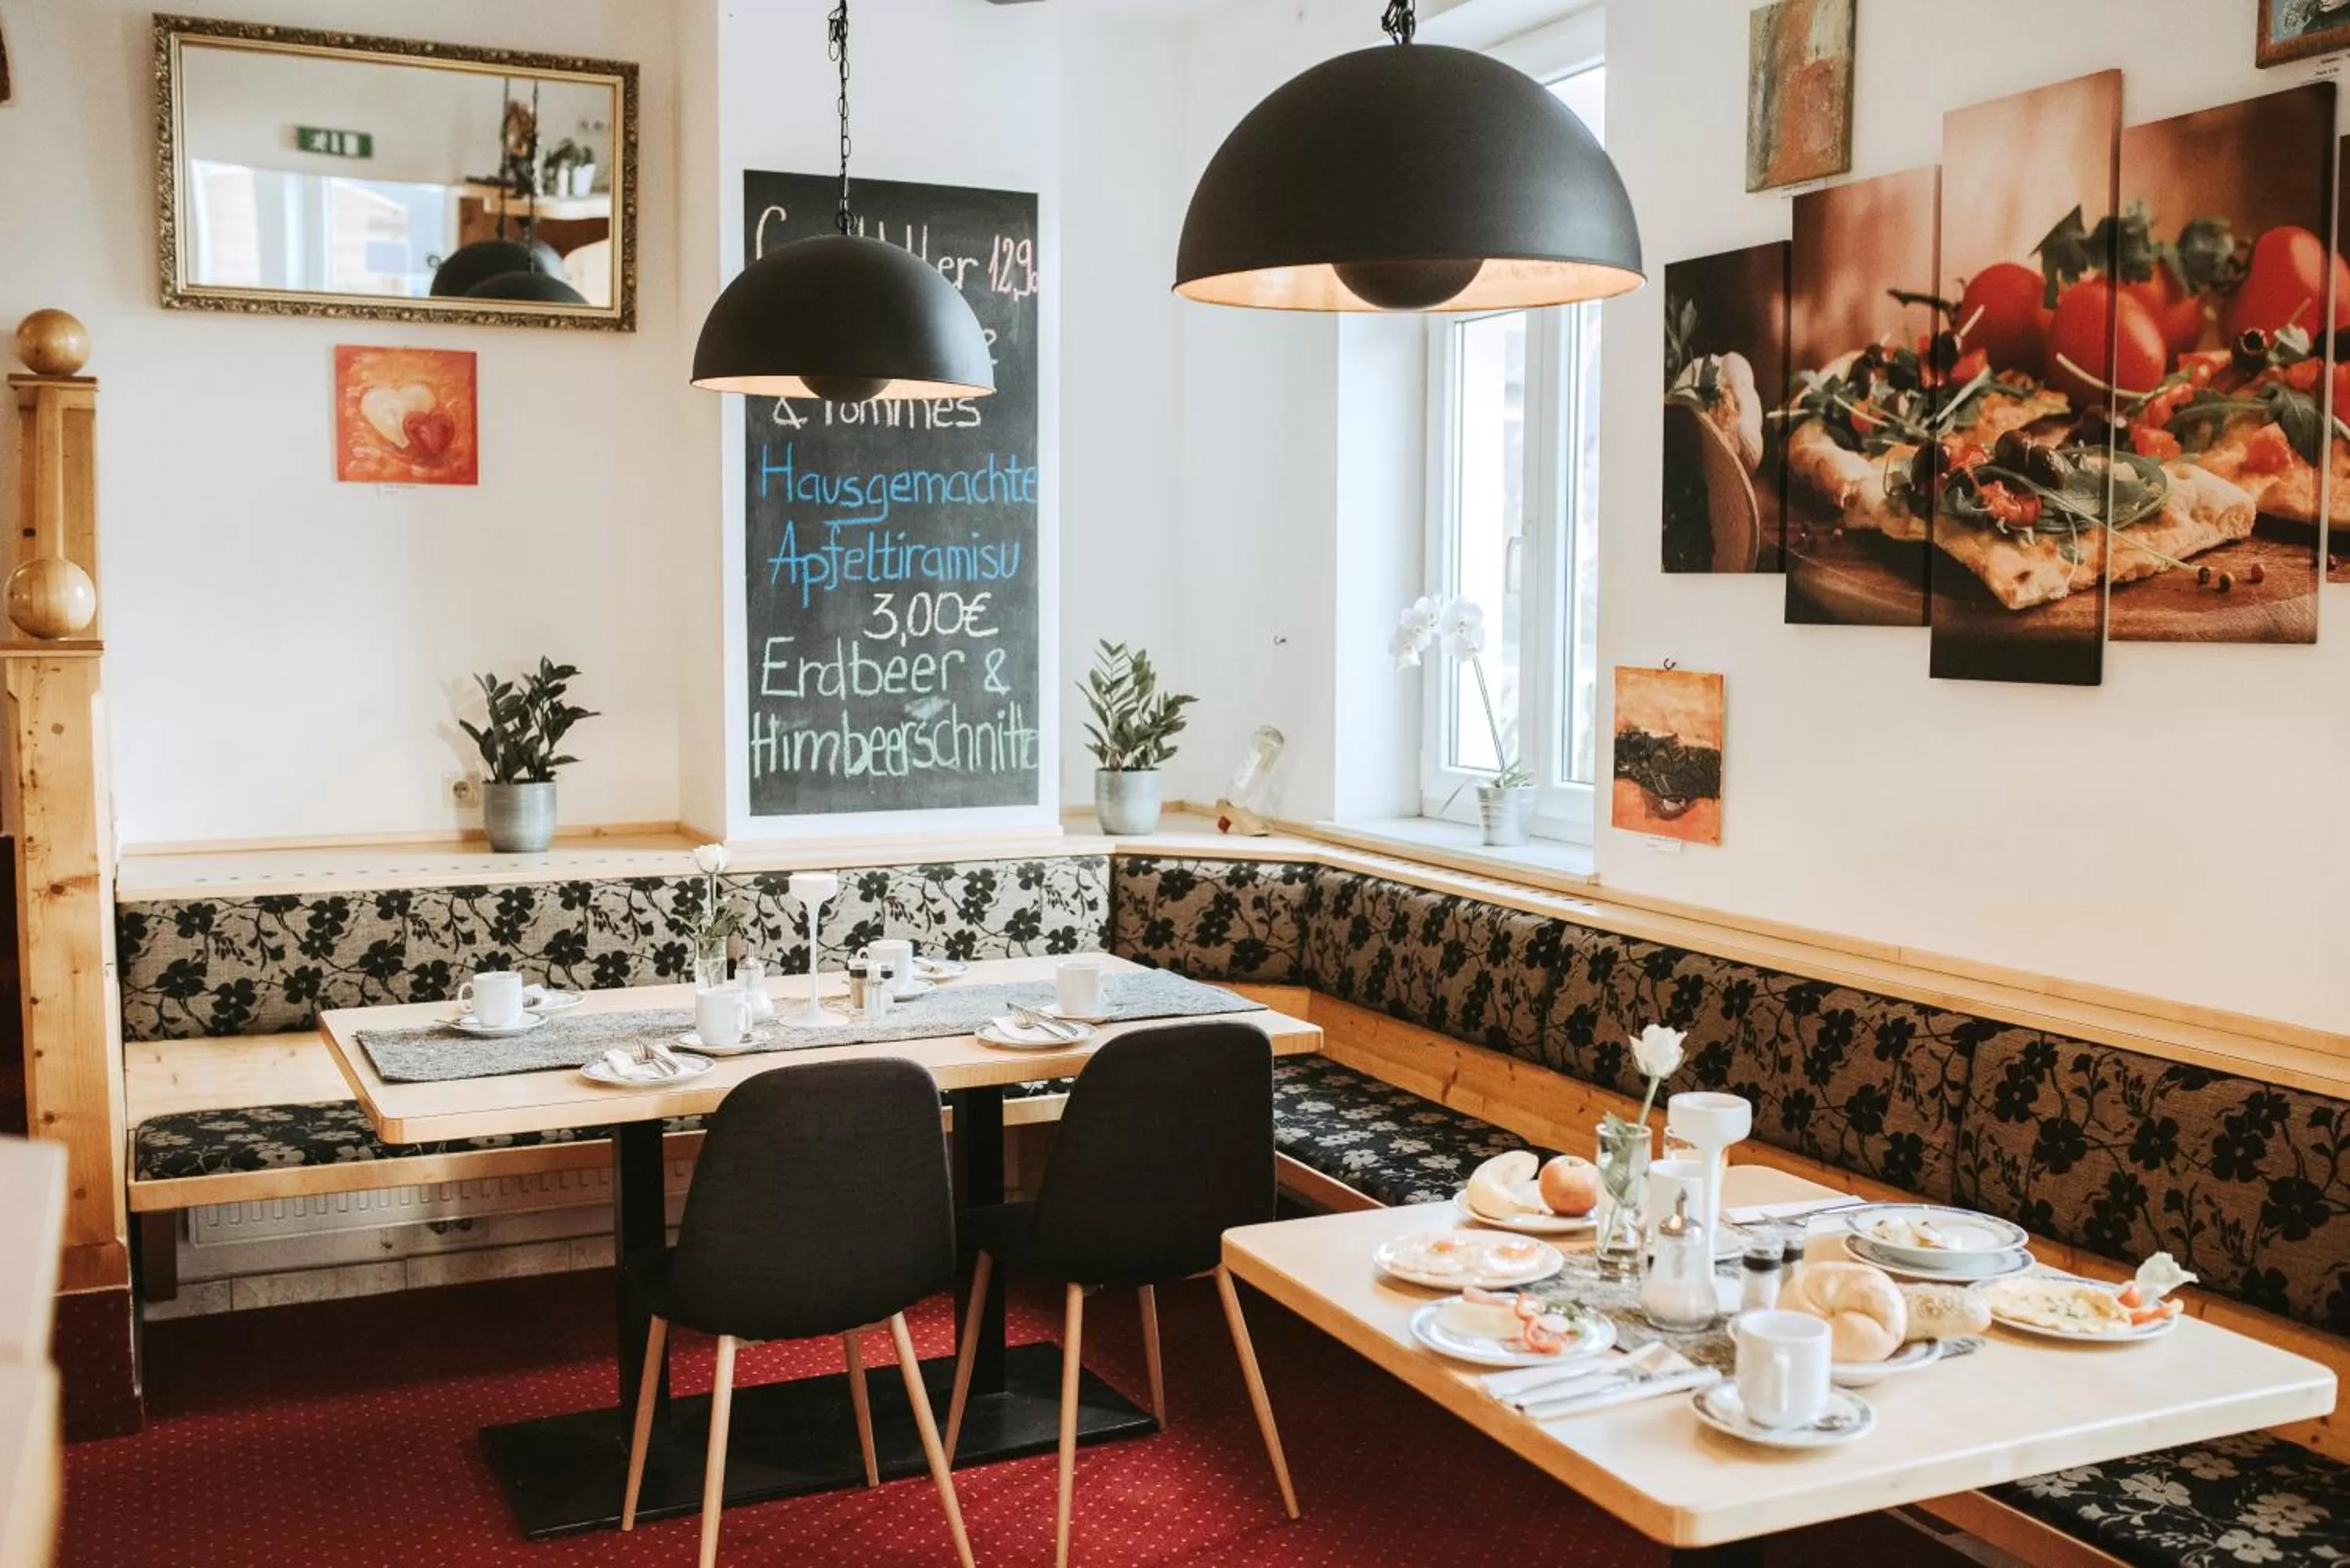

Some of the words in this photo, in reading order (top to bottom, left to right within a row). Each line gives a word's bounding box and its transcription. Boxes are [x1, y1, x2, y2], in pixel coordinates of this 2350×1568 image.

[760, 443, 1039, 526] Hausgemachte
[767, 520, 1021, 609] Apfeltiramisu
[862, 591, 999, 648] 3,00€
[760, 636, 966, 700] Erdbeer
[983, 648, 1012, 695] &
[750, 700, 1039, 779] Himbeerschnitte
